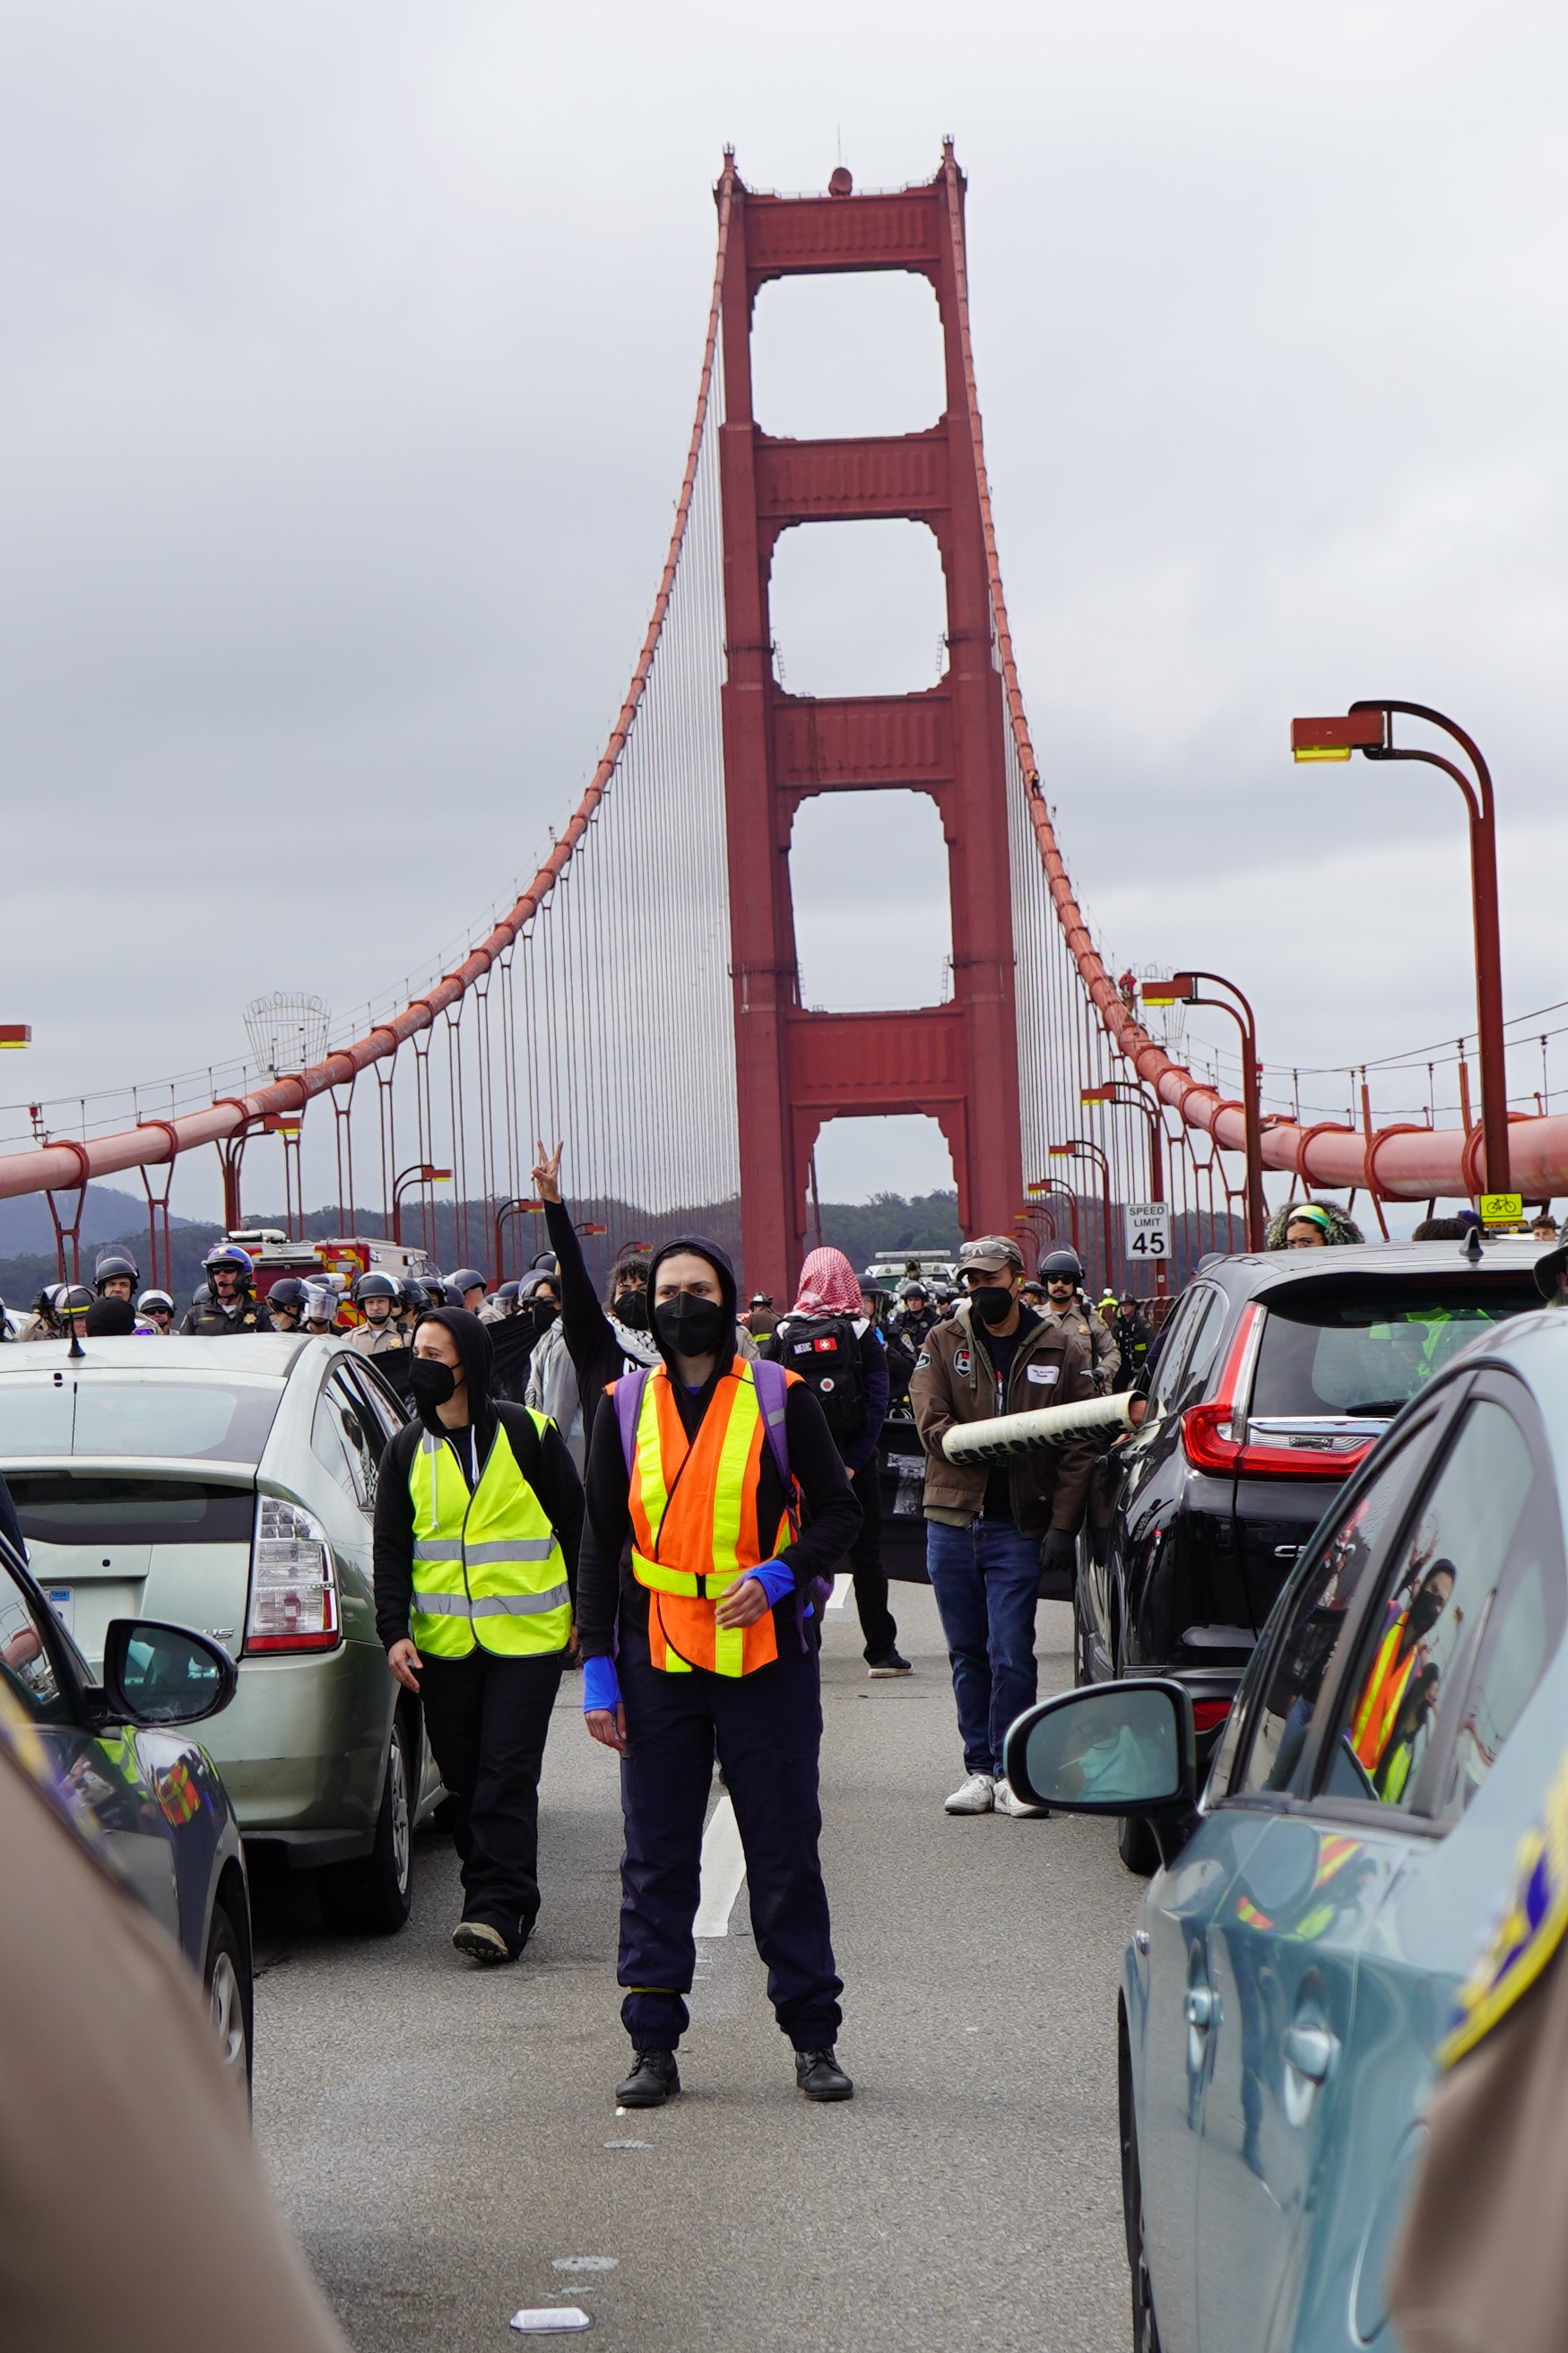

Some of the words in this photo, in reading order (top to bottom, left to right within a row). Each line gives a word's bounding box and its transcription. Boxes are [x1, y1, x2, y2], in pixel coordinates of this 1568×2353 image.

[1130, 1206, 1165, 1216] SPEED
[1134, 1218, 1161, 1227] LIMIT
[1132, 1232, 1165, 1255] 45
